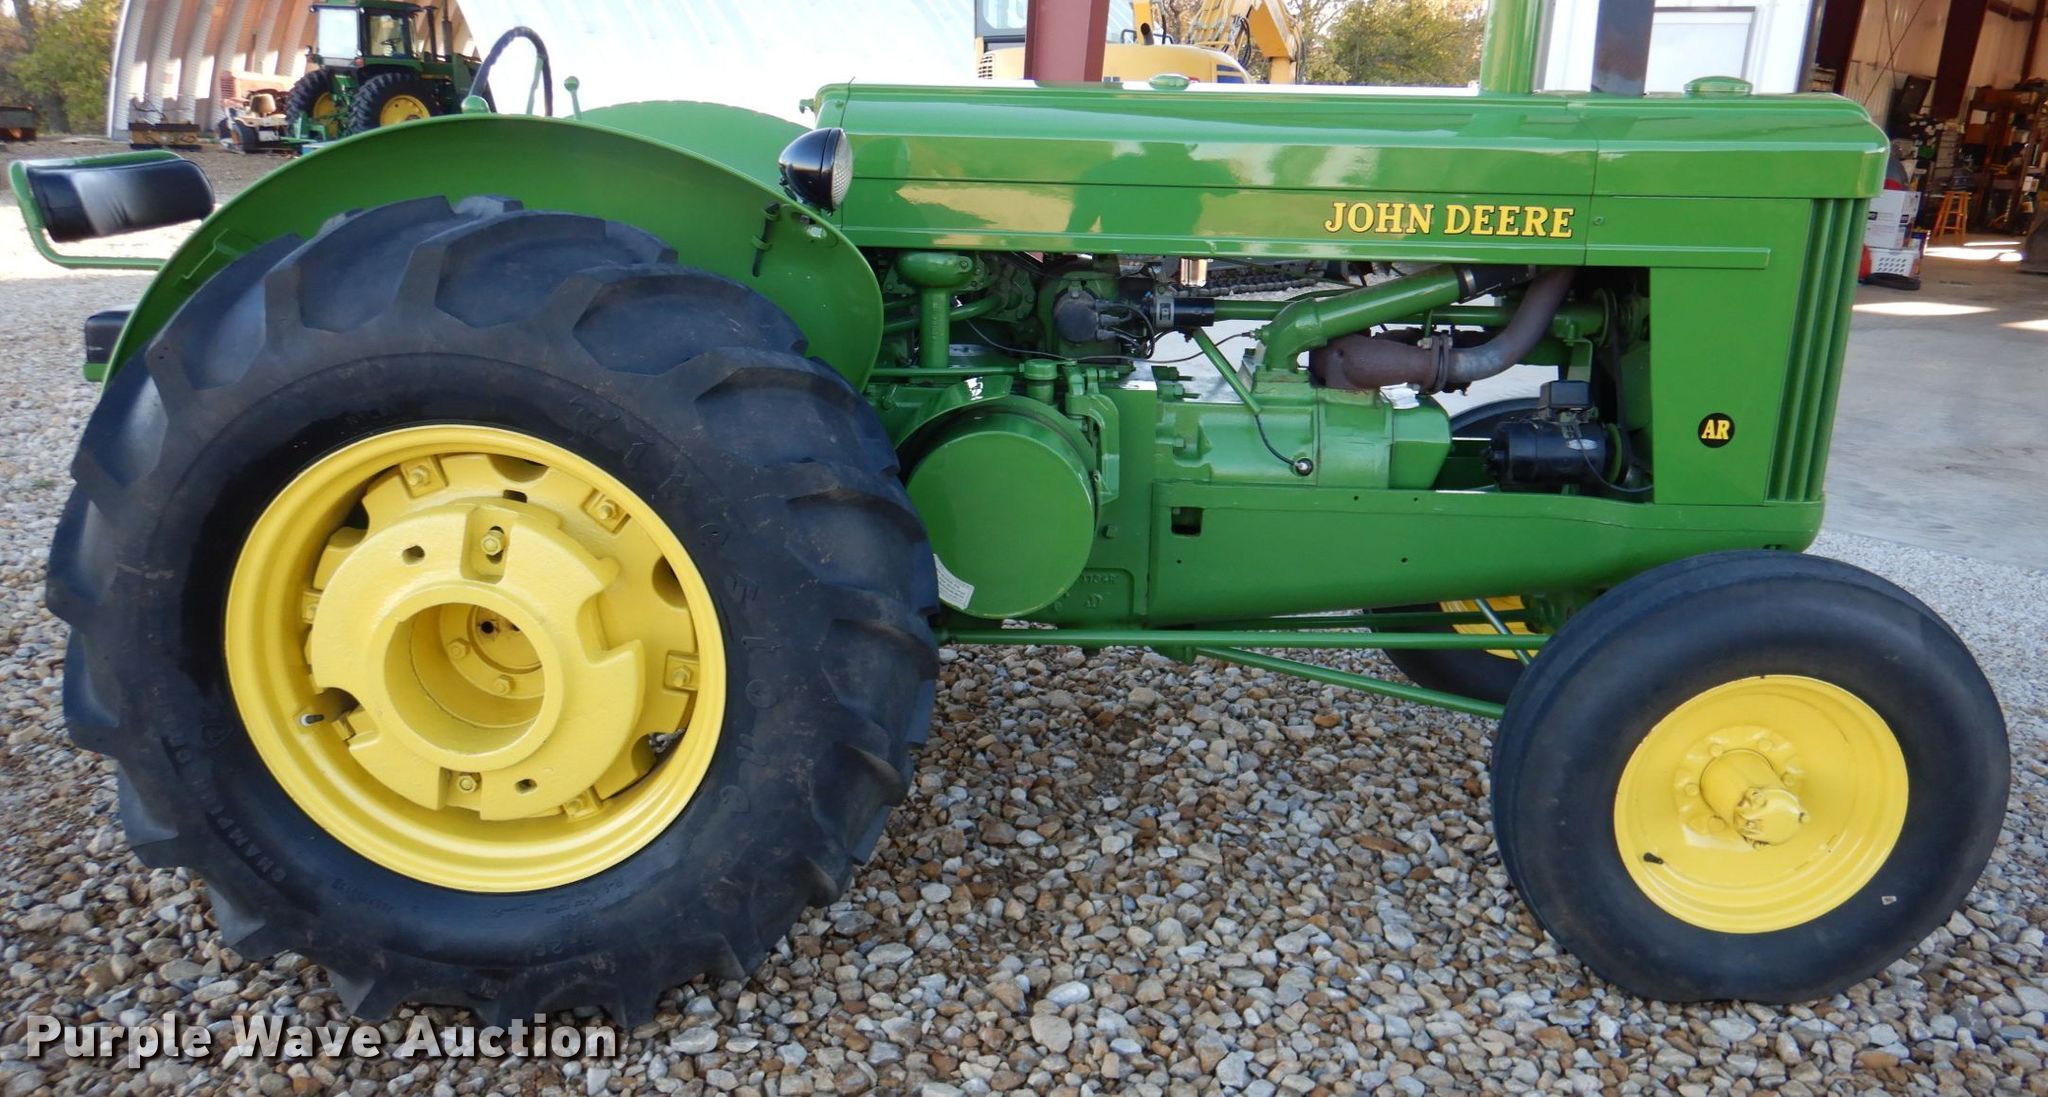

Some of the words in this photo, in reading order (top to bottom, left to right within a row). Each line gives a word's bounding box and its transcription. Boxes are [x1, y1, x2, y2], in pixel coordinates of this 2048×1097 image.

[1324, 202, 1434, 233] JOHN
[1444, 204, 1575, 238] DEERE
[1701, 419, 1730, 440] AR
